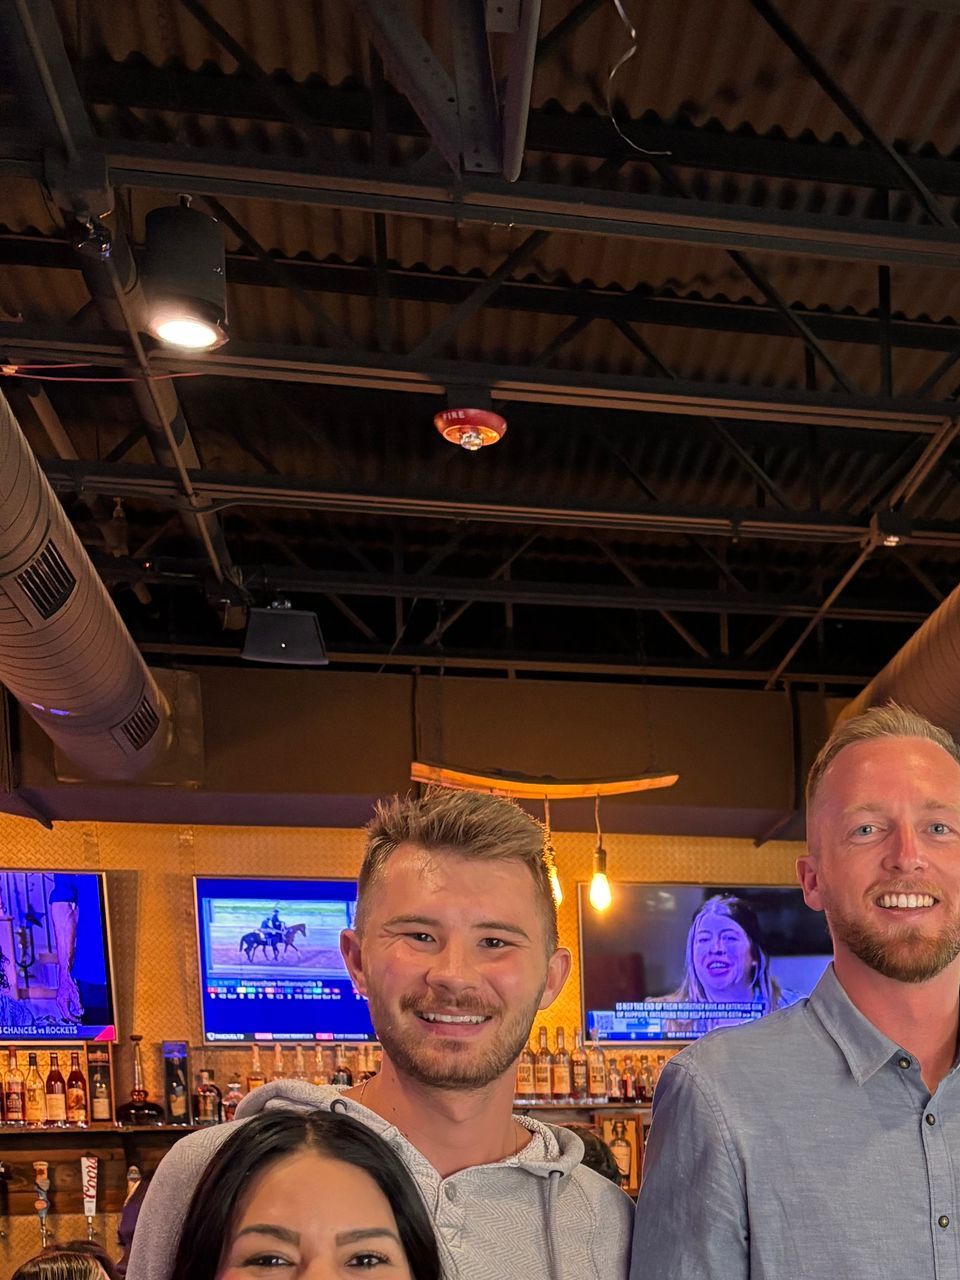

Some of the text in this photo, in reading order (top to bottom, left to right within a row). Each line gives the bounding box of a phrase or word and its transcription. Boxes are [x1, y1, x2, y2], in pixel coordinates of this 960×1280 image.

[442, 411, 465, 421] FIRE
[3, 1026, 37, 1034] CHANCES
[46, 1026, 78, 1034] ROCKETS
[83, 1157, 97, 1199] Coors
